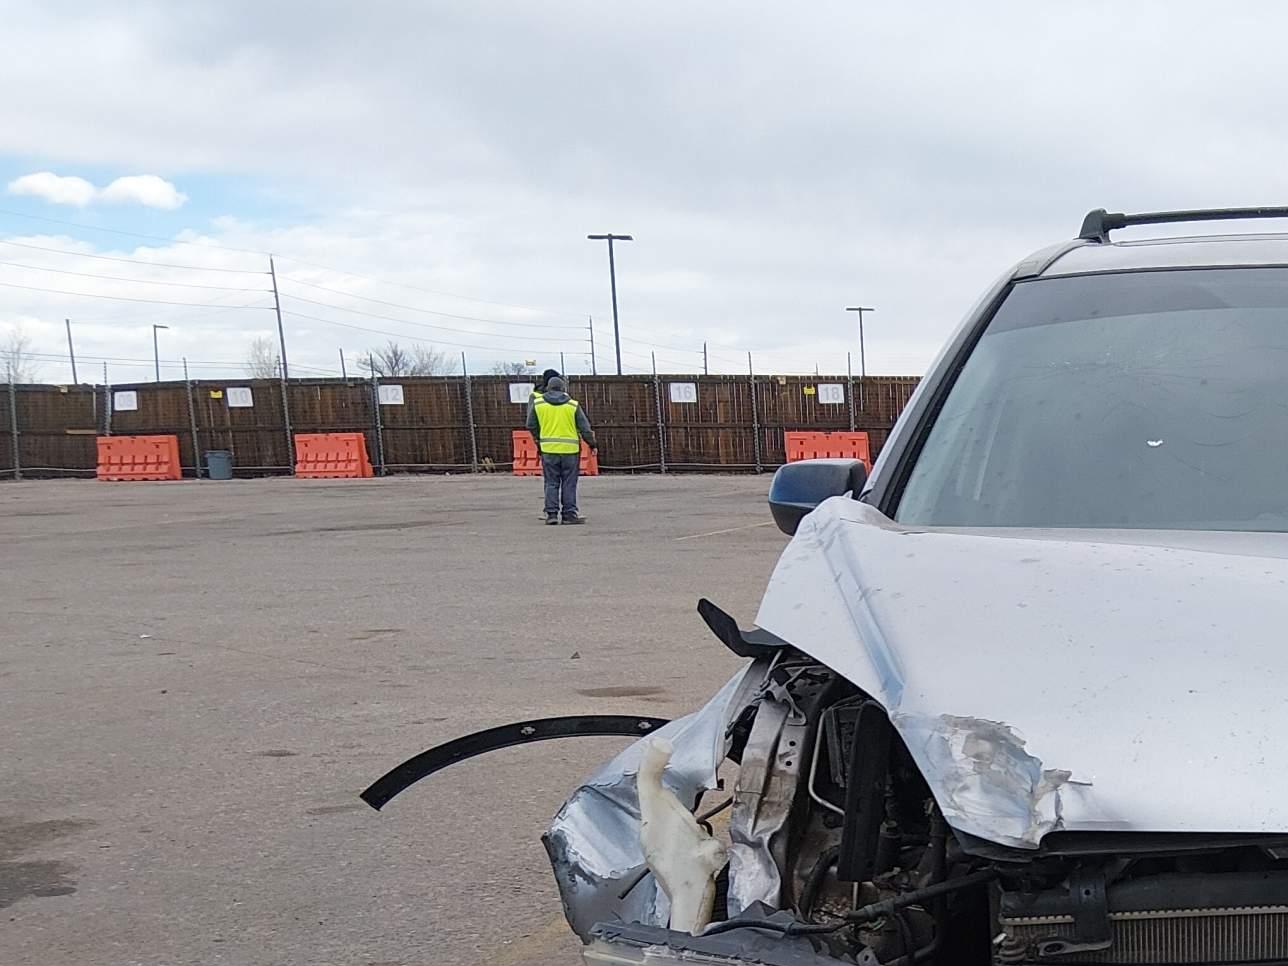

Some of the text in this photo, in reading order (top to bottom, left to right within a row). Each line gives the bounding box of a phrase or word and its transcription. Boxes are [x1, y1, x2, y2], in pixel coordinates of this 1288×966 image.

[230, 390, 248, 403] 10
[384, 388, 399, 400] 12
[677, 386, 691, 399] 16
[825, 387, 840, 400] 18
